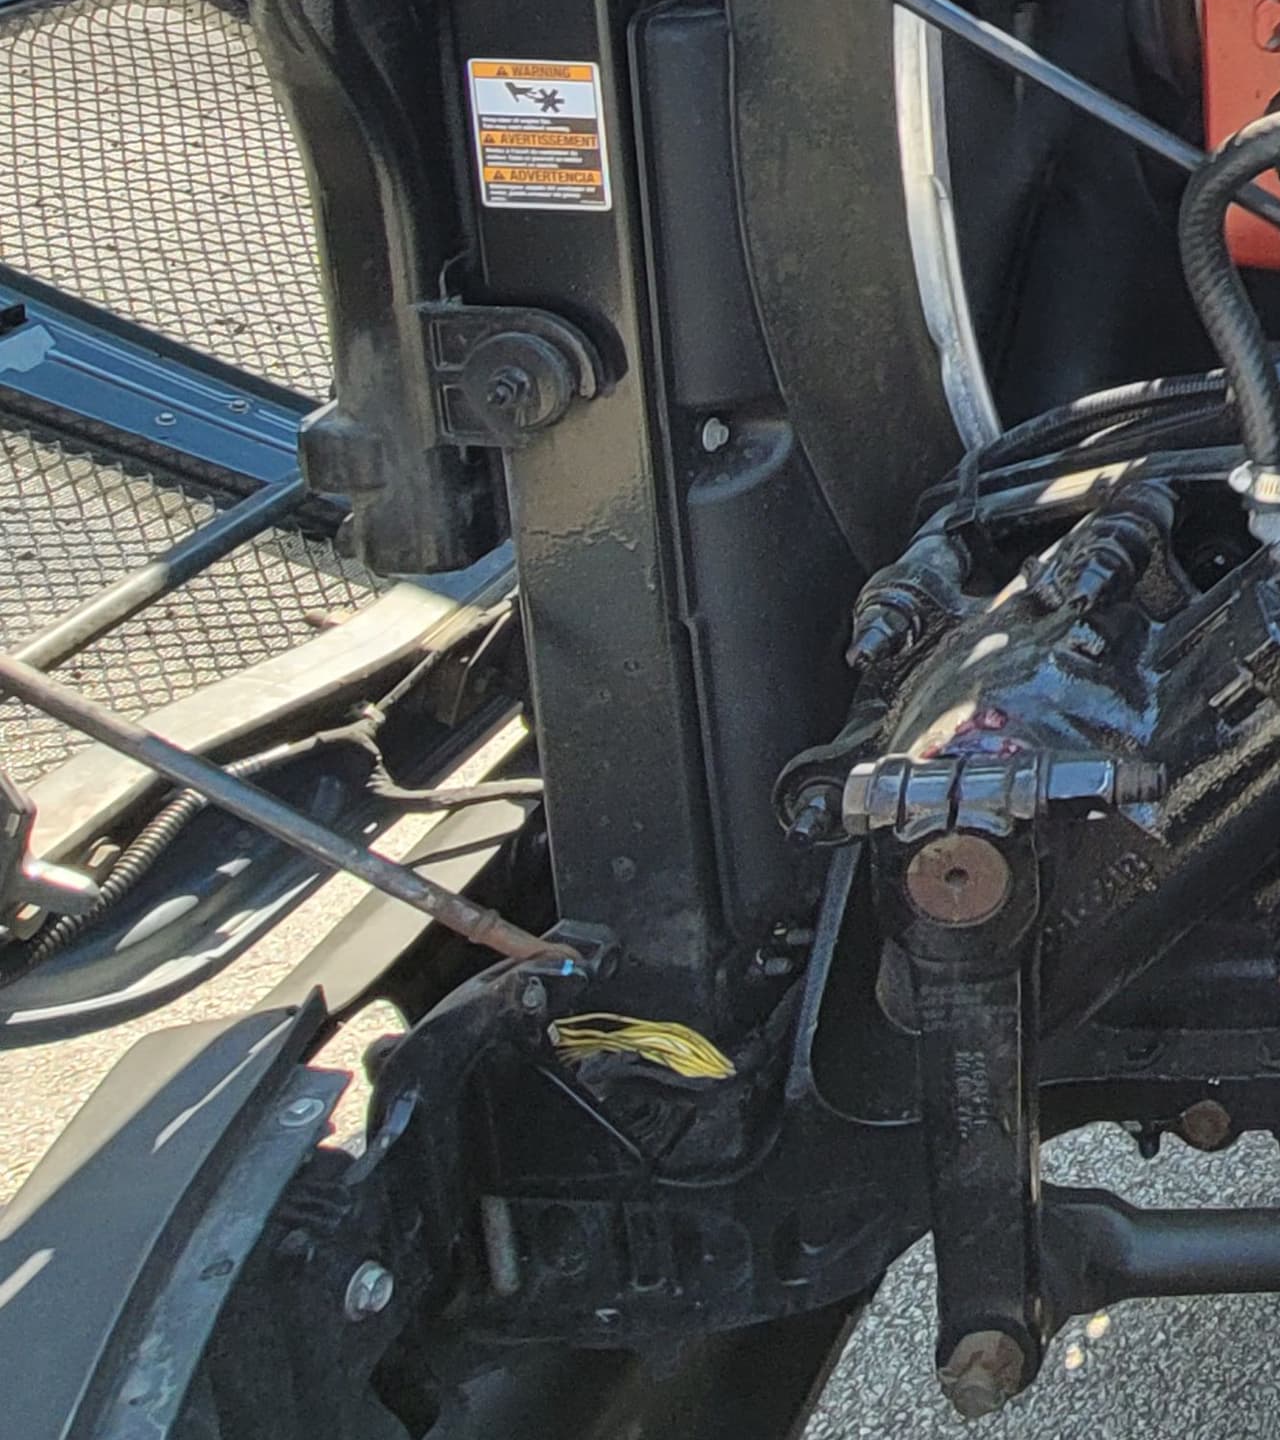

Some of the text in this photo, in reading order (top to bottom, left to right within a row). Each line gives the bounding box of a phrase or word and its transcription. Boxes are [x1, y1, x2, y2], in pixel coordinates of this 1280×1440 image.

[512, 63, 571, 78] WARNING
[500, 133, 597, 148] AVERTISSEMENT
[510, 169, 596, 183] ADVERTENCIA
